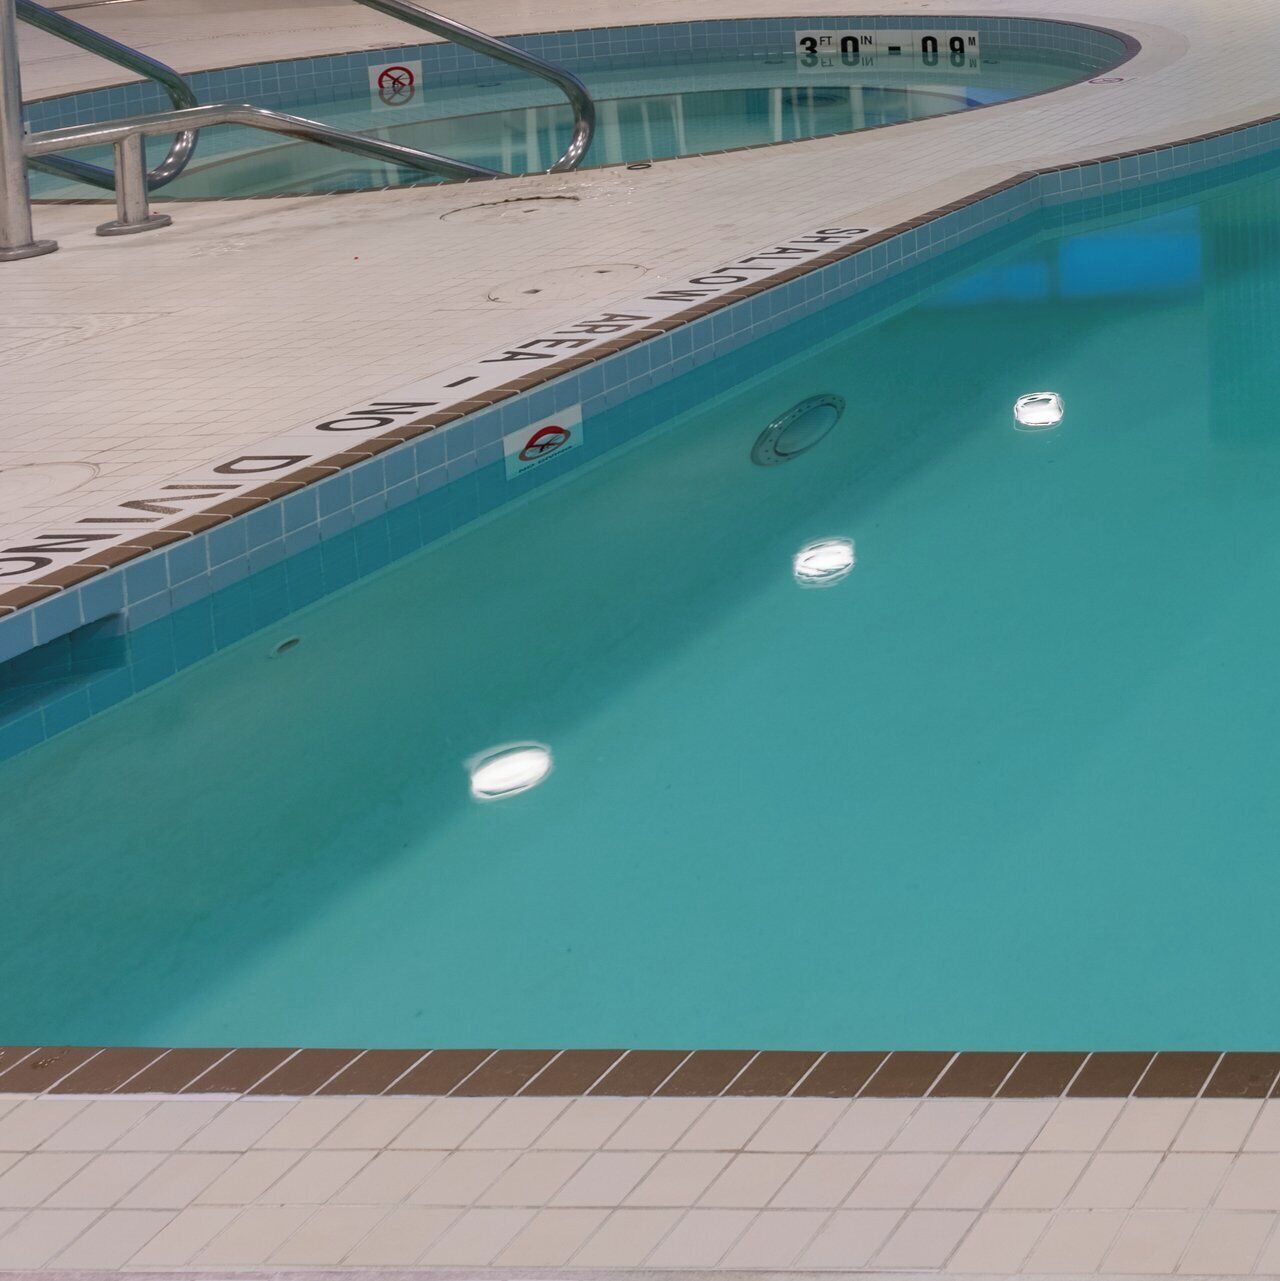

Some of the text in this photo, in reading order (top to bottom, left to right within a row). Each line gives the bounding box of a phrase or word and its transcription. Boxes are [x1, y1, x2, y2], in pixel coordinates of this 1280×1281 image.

[644, 227, 870, 302] SHALLOW
[478, 312, 652, 364] AREA
[315, 401, 439, 432] NO
[0, 454, 312, 577] DIVING
